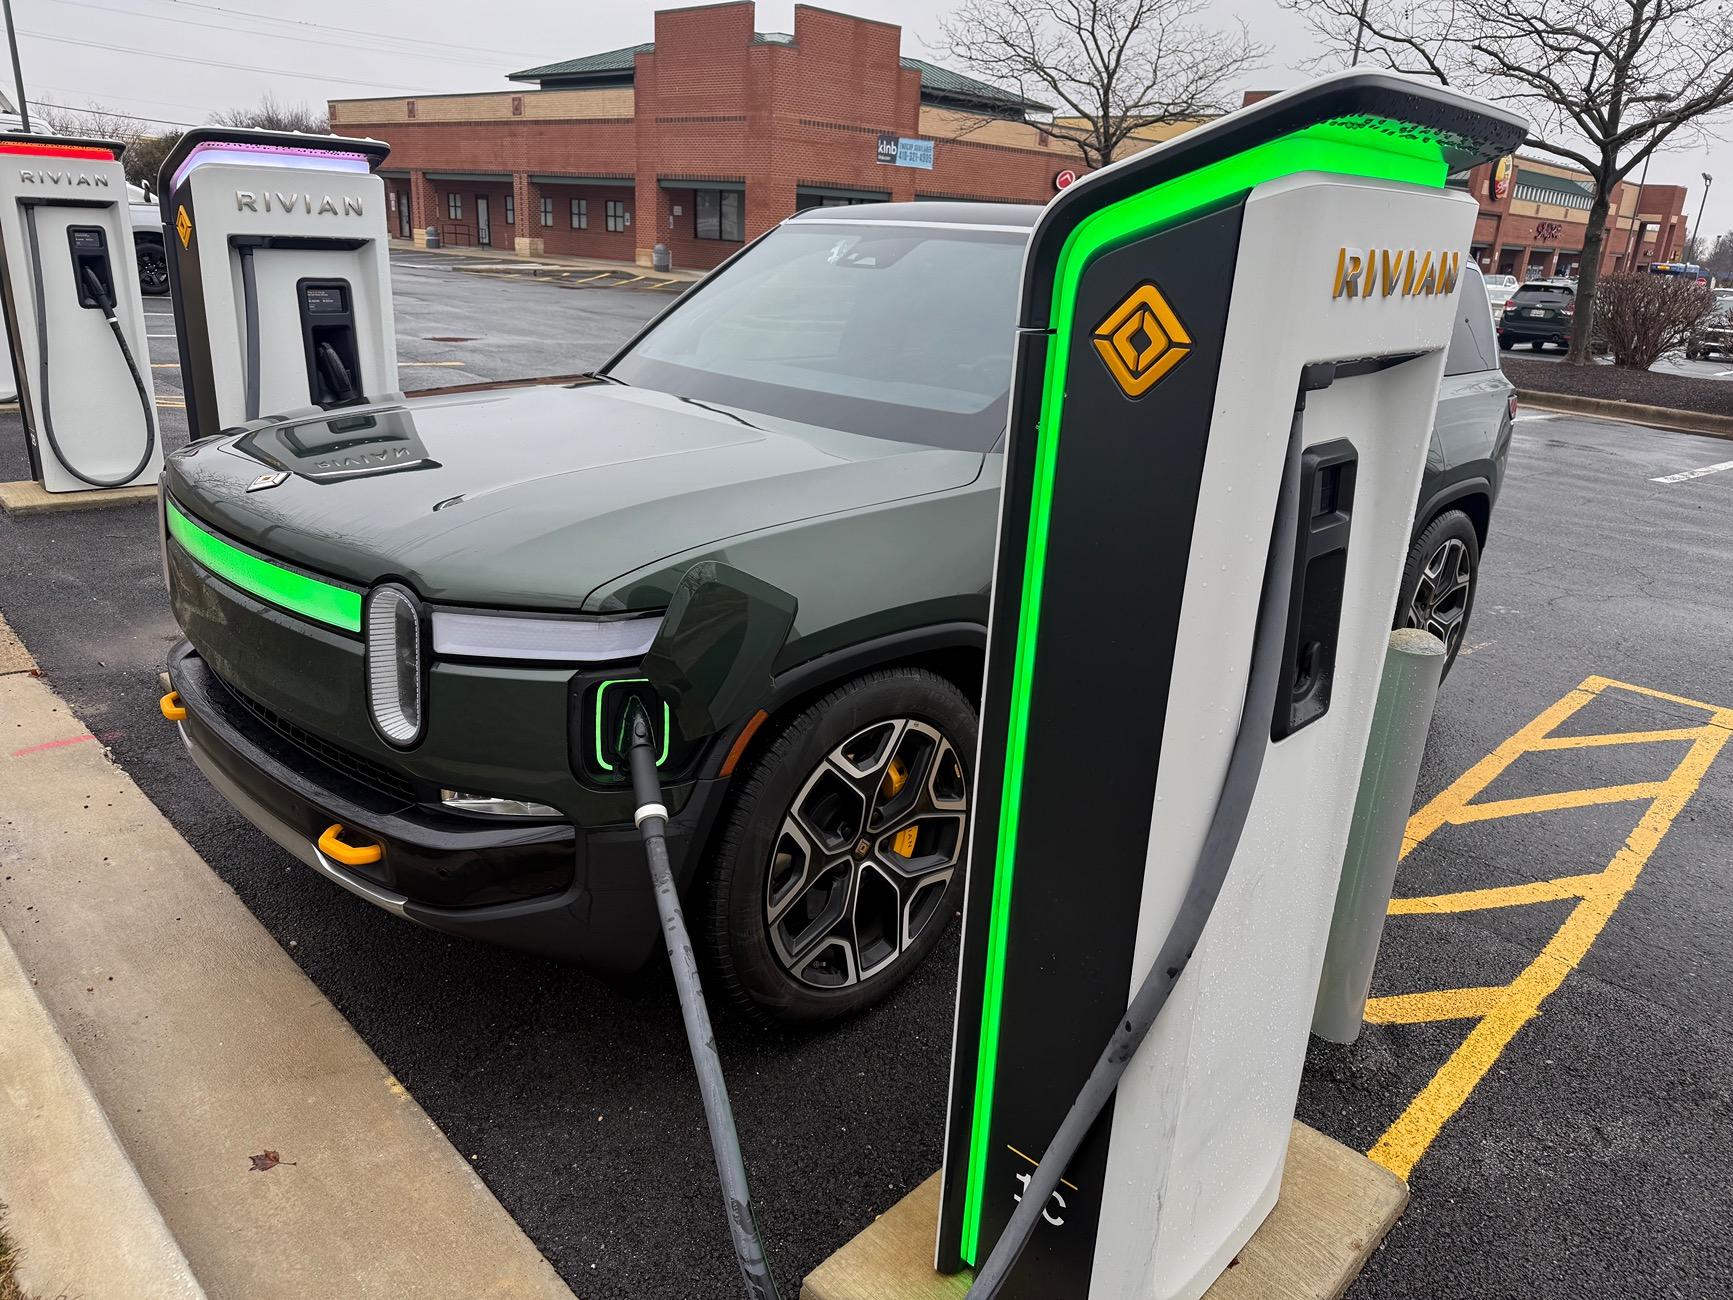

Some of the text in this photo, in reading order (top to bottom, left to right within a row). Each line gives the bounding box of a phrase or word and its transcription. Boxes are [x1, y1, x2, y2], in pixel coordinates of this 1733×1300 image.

[878, 140, 897, 155] klnb
[19, 170, 108, 187] RIVIAN
[236, 190, 363, 216] RIVIAN
[1333, 247, 1460, 299] RIVIAN
